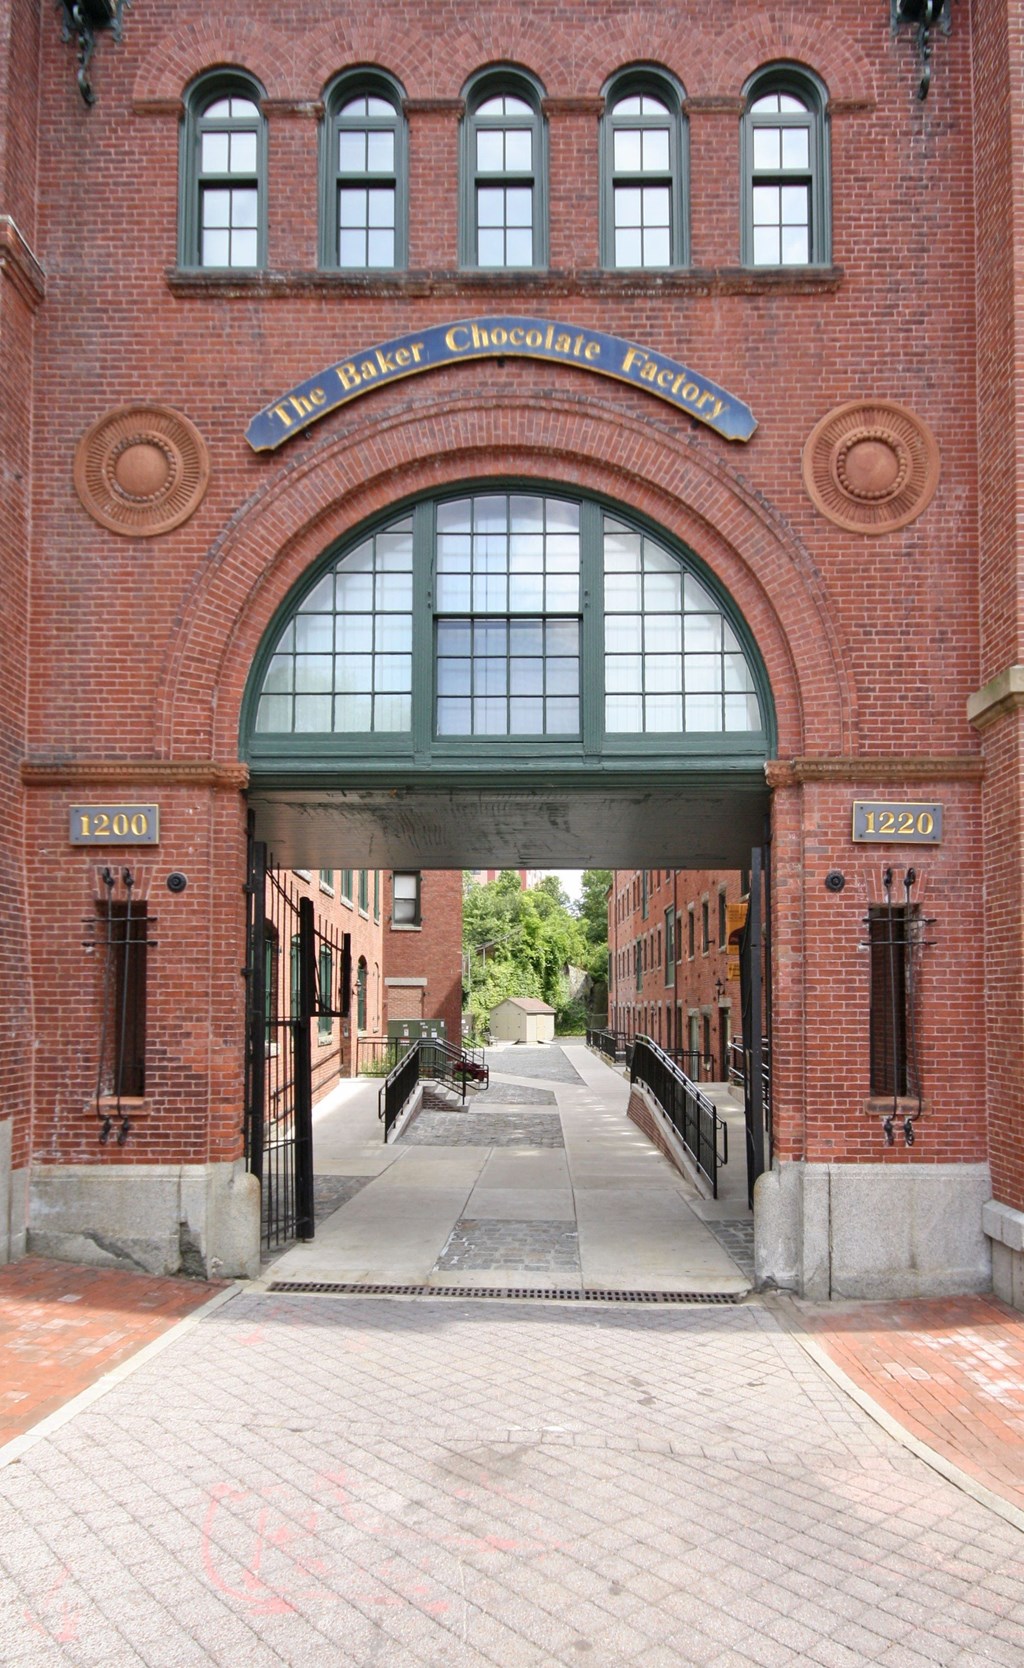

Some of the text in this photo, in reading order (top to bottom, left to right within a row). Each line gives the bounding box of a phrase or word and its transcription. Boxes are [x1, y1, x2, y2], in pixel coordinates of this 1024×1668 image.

[270, 325, 730, 428] The Baker Chocolate Factory
[80, 813, 148, 836] 1200
[864, 812, 934, 835] 1220
